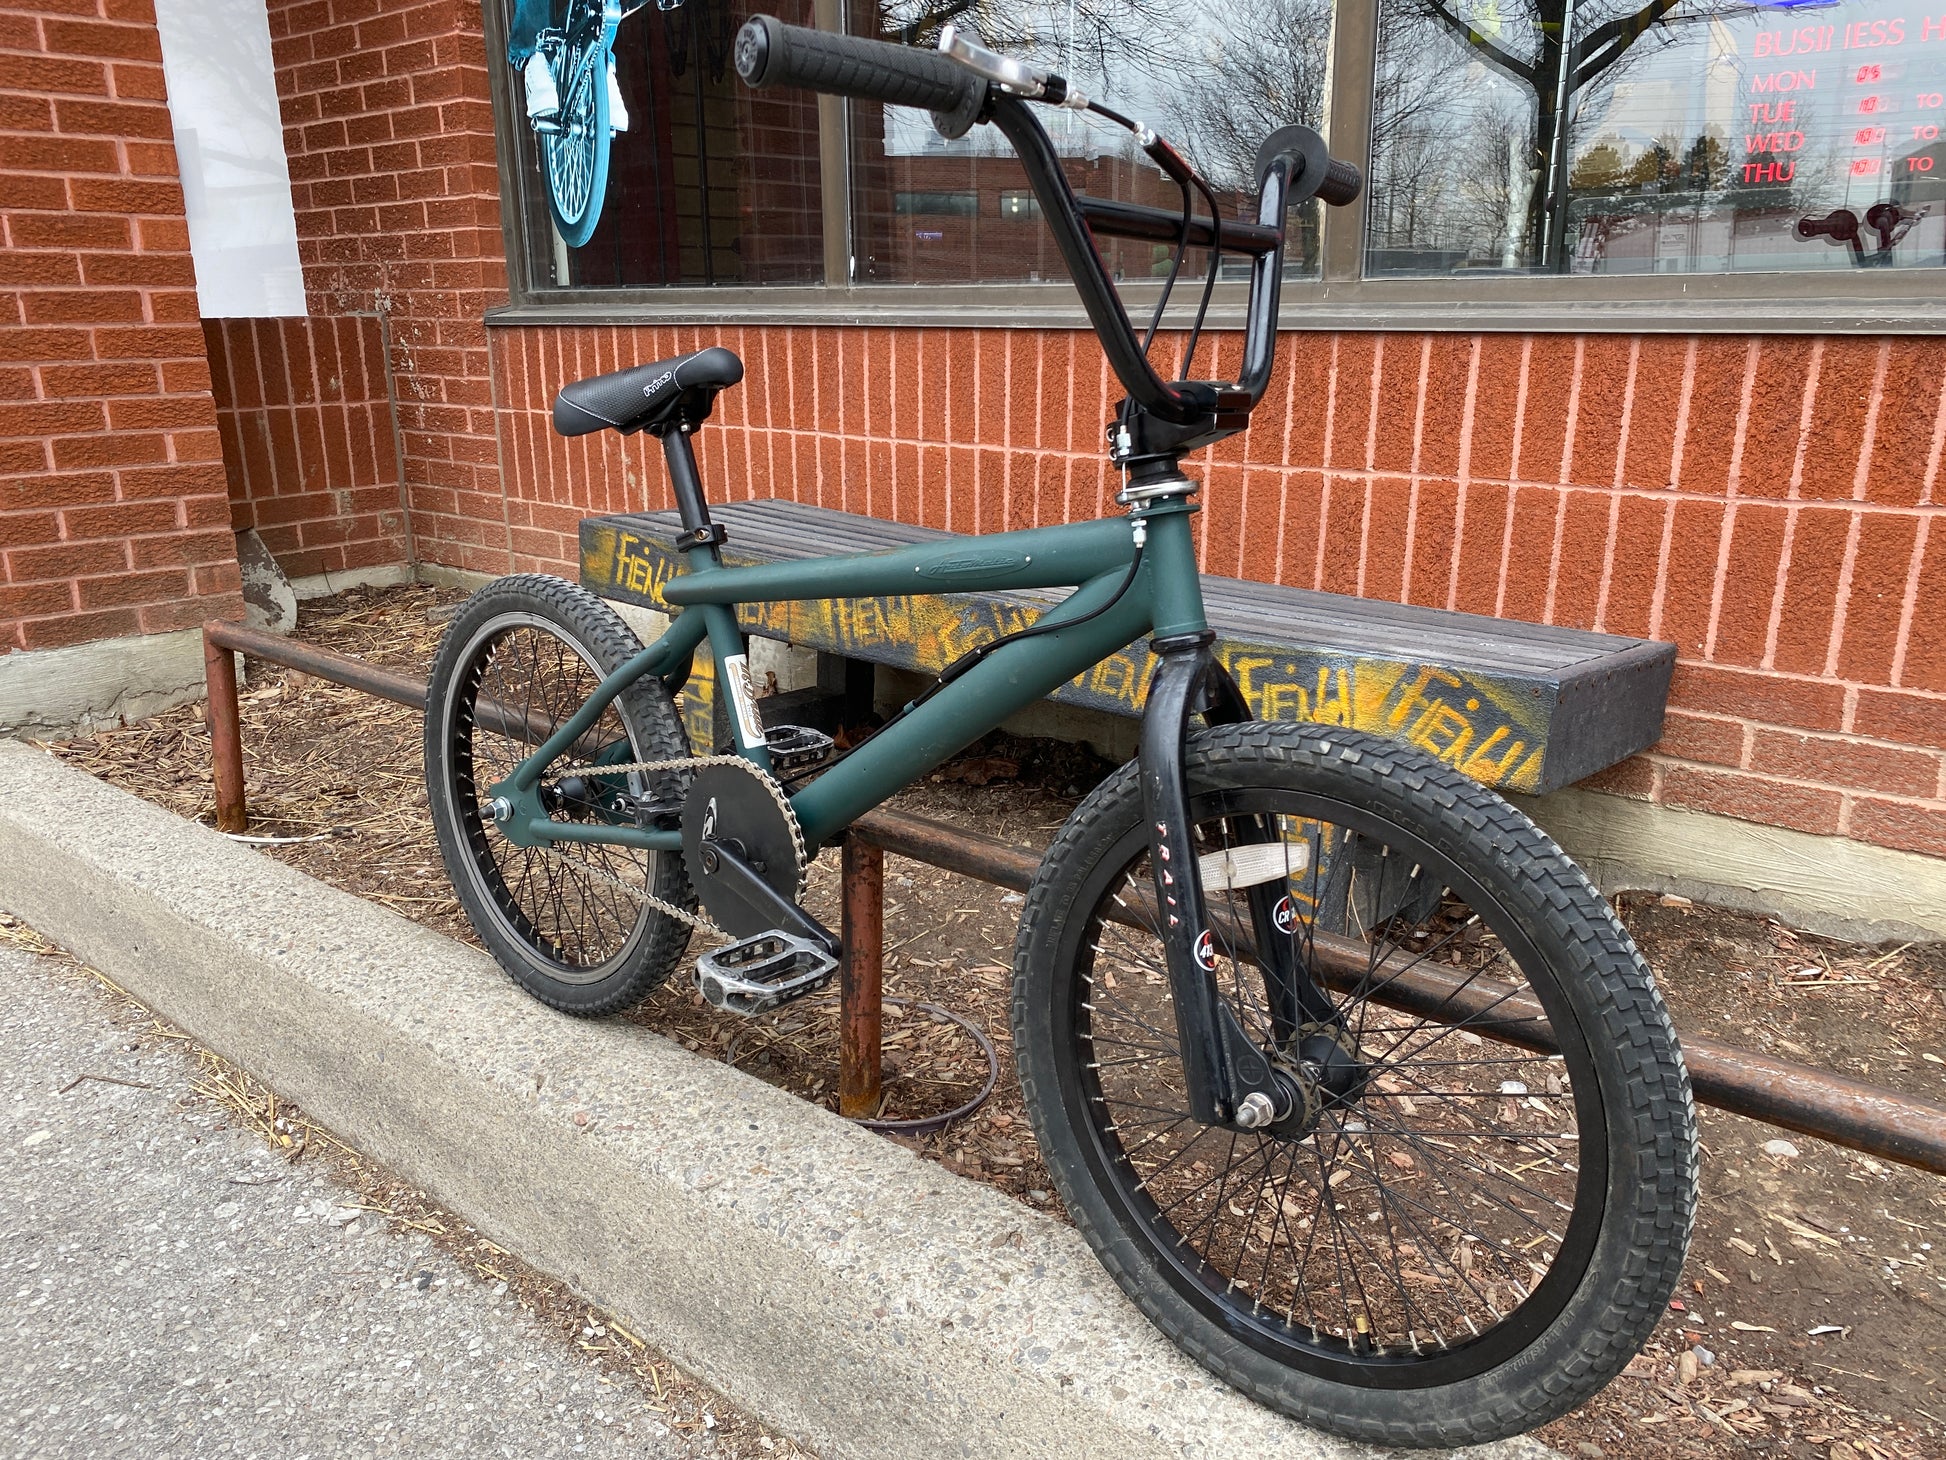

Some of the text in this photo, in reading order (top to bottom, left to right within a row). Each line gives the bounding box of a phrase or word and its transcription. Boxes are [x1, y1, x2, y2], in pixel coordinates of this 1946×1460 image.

[1751, 69, 1816, 93] MON
[1749, 101, 1797, 124] TUE
[1916, 92, 1944, 109] TO
[1745, 131, 1805, 154] WED
[1912, 125, 1939, 140] TO
[1742, 161, 1797, 183] THU
[1907, 157, 1934, 172] TO
